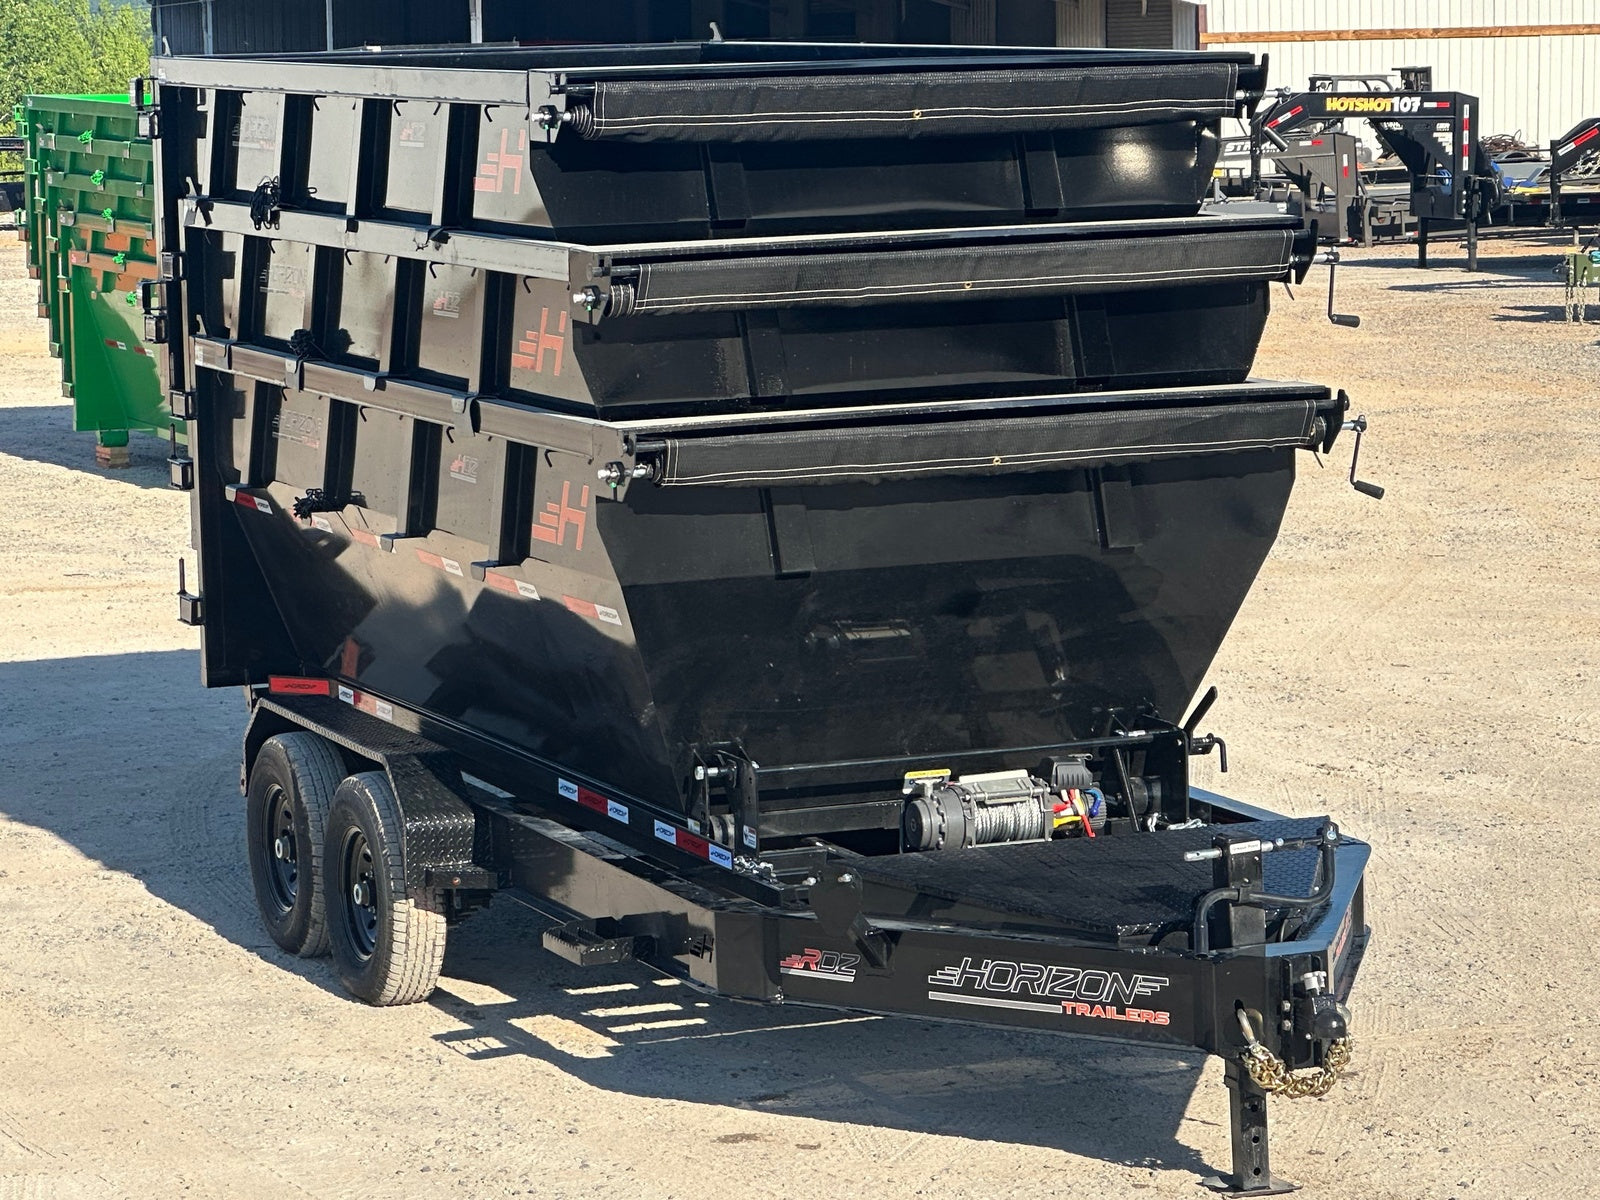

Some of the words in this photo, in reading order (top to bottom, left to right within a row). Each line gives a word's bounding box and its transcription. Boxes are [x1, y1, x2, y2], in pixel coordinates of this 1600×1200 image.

[1326, 97, 1421, 112] HOTSHOT107
[800, 947, 861, 976] RDZ
[955, 957, 1140, 1005] HORIZON
[1061, 1001, 1170, 1026] TRAILERS
